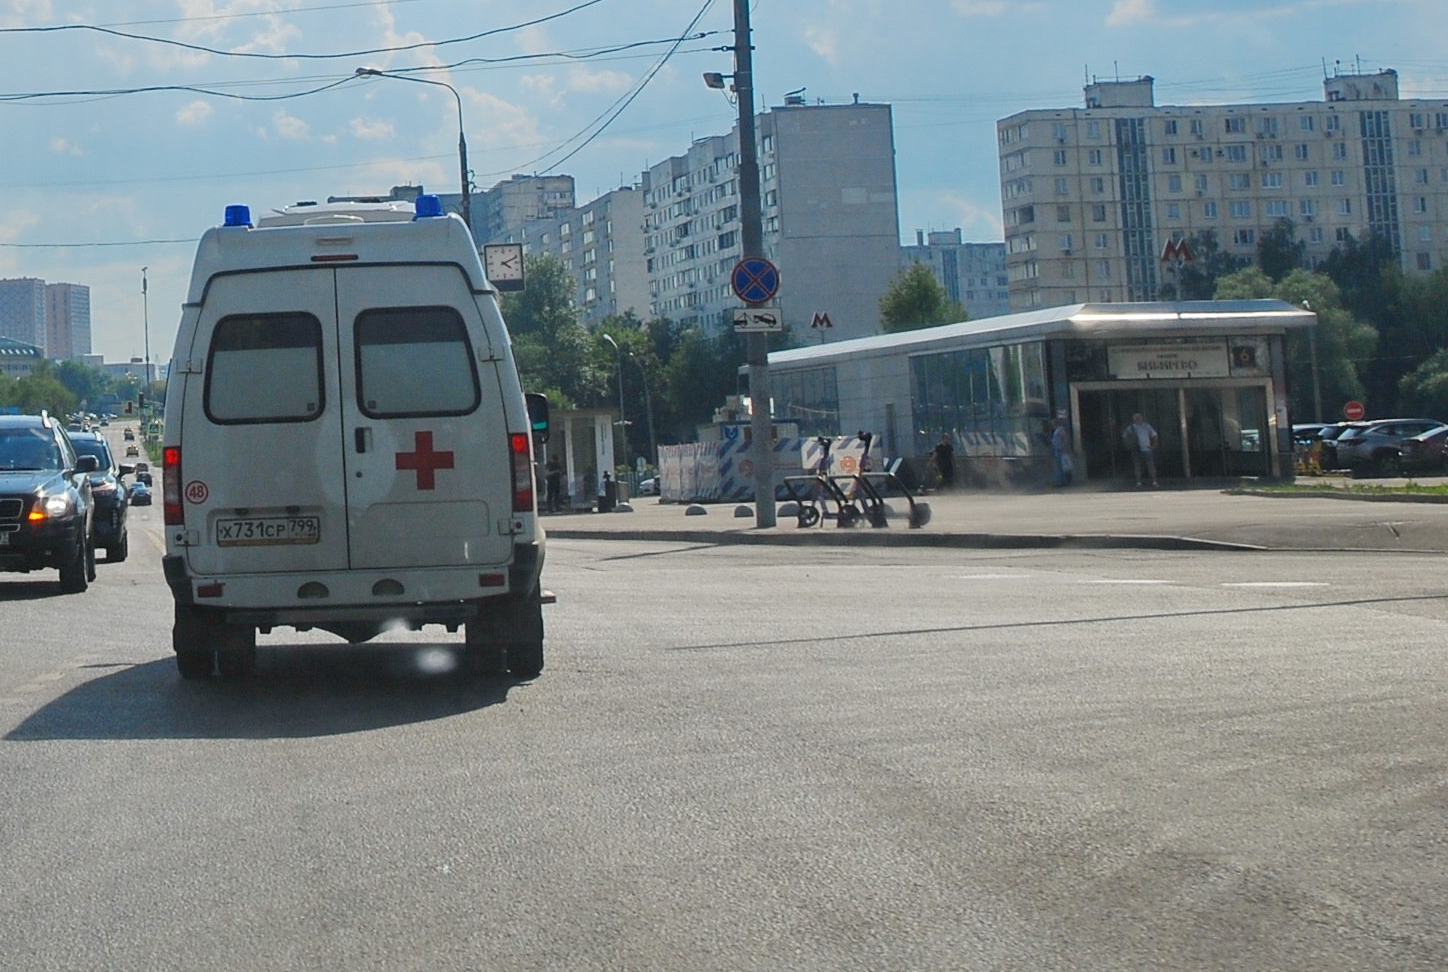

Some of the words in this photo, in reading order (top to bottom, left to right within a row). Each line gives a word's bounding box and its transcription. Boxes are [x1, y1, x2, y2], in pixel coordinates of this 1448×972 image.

[189, 485, 205, 498] 48
[223, 521, 286, 539] Х731СР
[289, 519, 314, 533] 799
